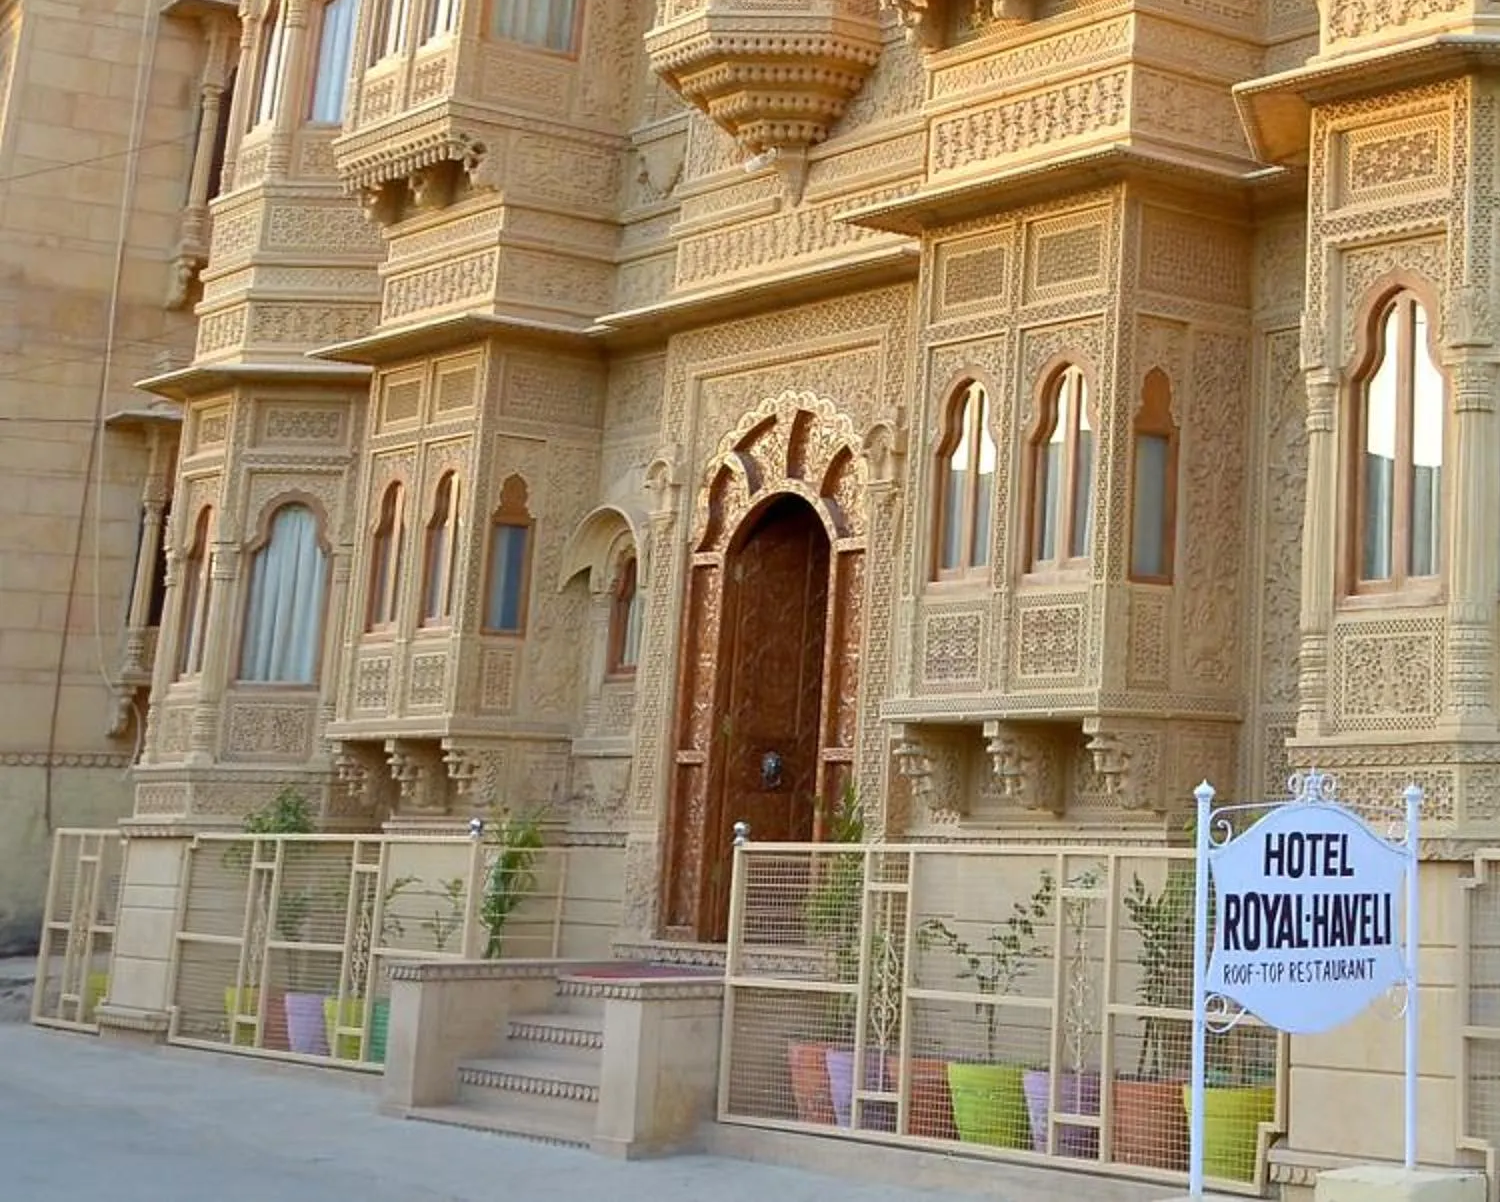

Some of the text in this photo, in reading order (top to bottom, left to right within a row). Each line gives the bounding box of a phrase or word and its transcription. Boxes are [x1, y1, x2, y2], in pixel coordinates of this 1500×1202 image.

[1263, 831, 1355, 878] HOTEL
[1223, 957, 1377, 985] ROOF-TOP RESTAURANT
